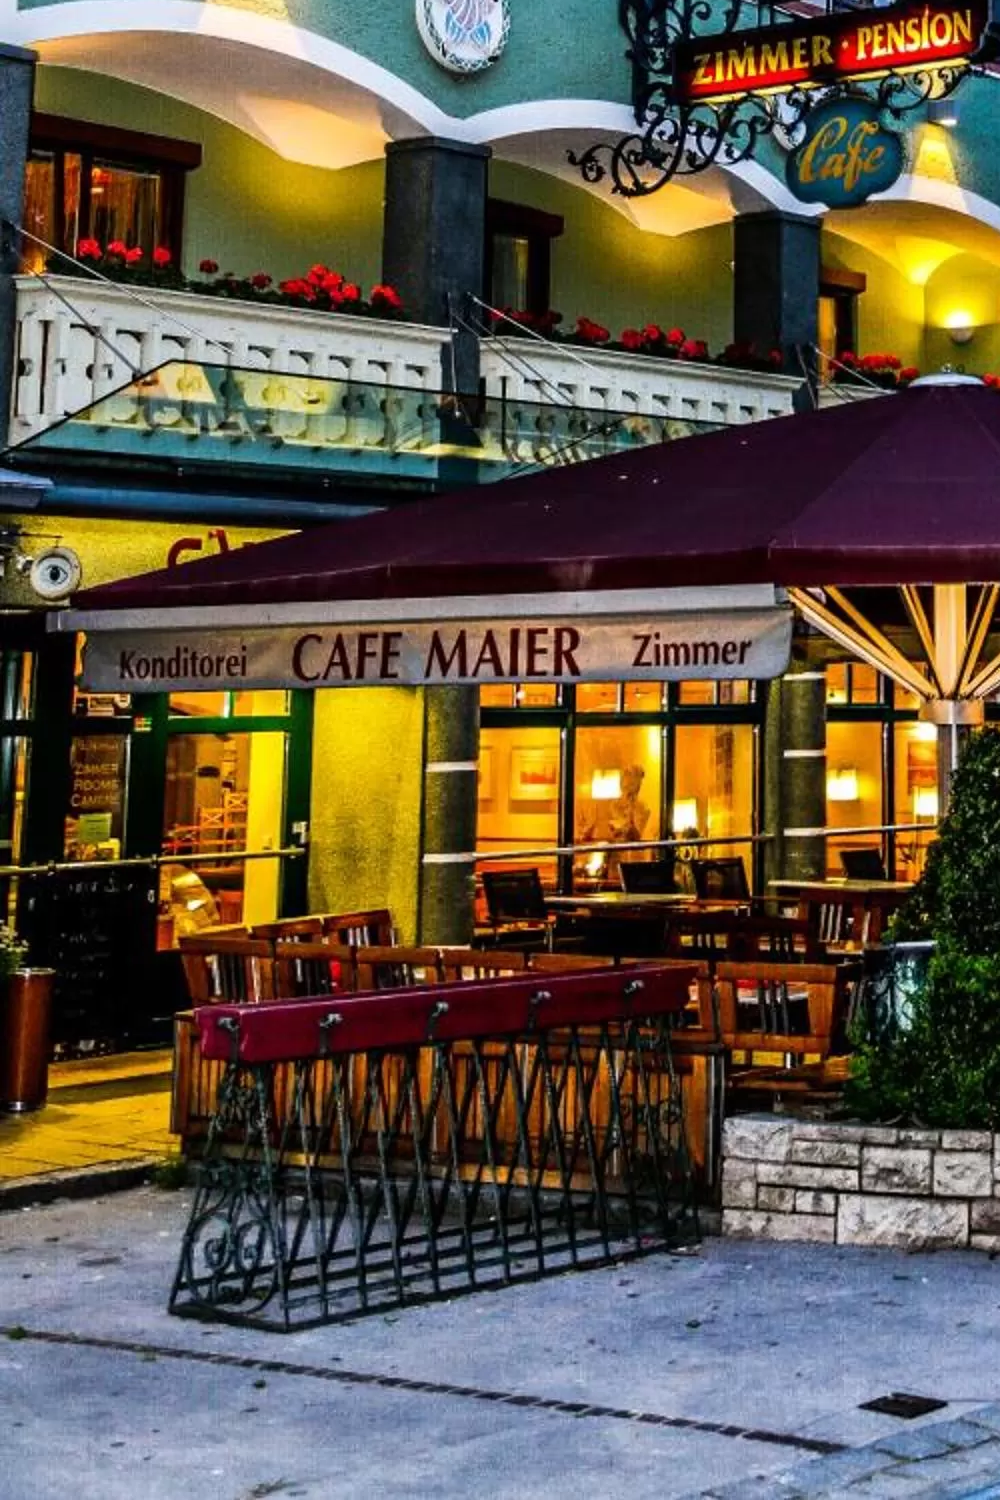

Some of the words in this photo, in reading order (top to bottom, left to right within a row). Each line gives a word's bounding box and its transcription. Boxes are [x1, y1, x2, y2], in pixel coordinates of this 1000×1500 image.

[691, 34, 835, 86] ZIMMER
[855, 6, 973, 61] PENSION
[119, 645, 248, 679] Konditorei
[291, 631, 403, 682] CAFE
[424, 626, 582, 679] MAIER
[632, 632, 753, 667] Zimmer
